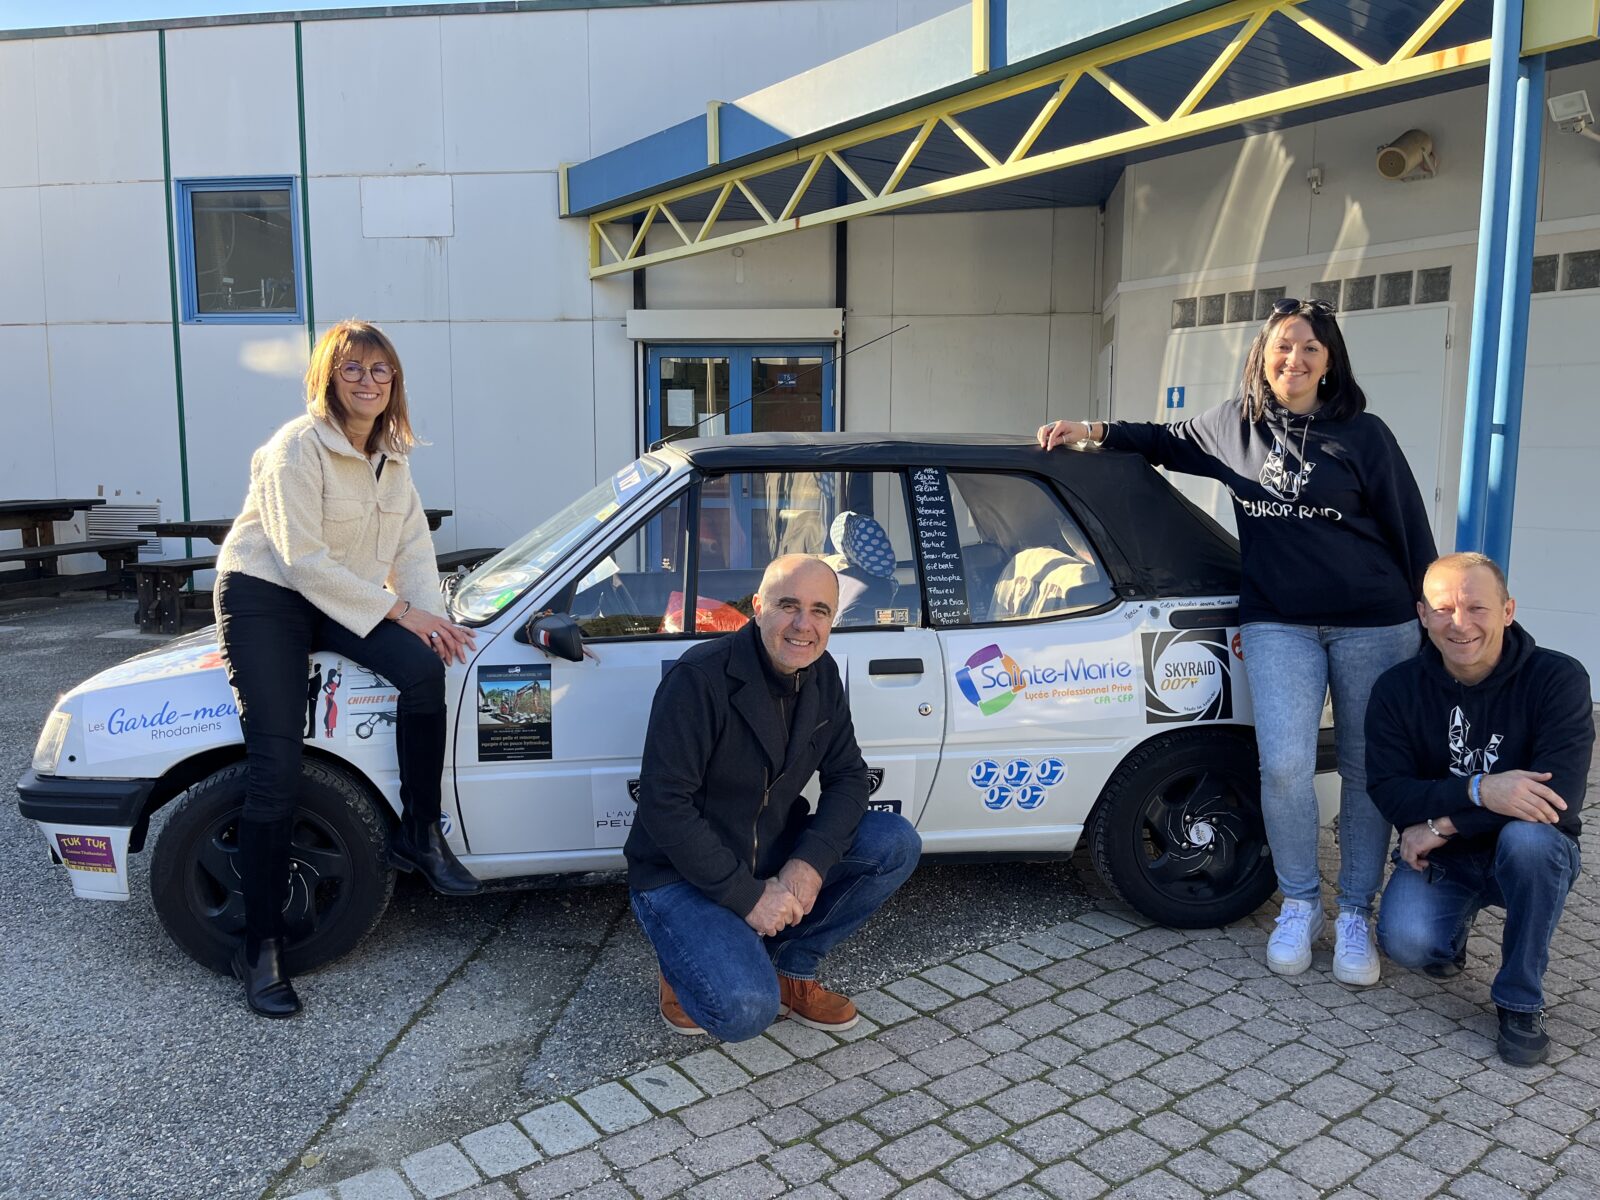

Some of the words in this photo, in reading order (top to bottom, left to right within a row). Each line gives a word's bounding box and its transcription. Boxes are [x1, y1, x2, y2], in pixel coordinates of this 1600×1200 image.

[917, 518, 947, 527] Jérémie
[981, 658, 1132, 688] Sainte-Marie
[1164, 660, 1216, 678] SKYRAID
[1025, 691, 1049, 701] Lycée
[1052, 685, 1109, 697] Professionnel
[1112, 683, 1133, 692] Privé
[1160, 677, 1191, 691] 007
[347, 695, 386, 705] CHIFFLET
[88, 722, 105, 733] Les
[107, 700, 240, 736] Garde-meu
[151, 721, 222, 740] Rhodaniens
[970, 761, 1000, 786] 07
[1003, 761, 1032, 785] 07
[1035, 760, 1065, 784] 07
[984, 786, 1013, 808] 07
[1016, 785, 1045, 808] 07
[61, 837, 81, 847] TUK
[85, 838, 106, 850] TUK
